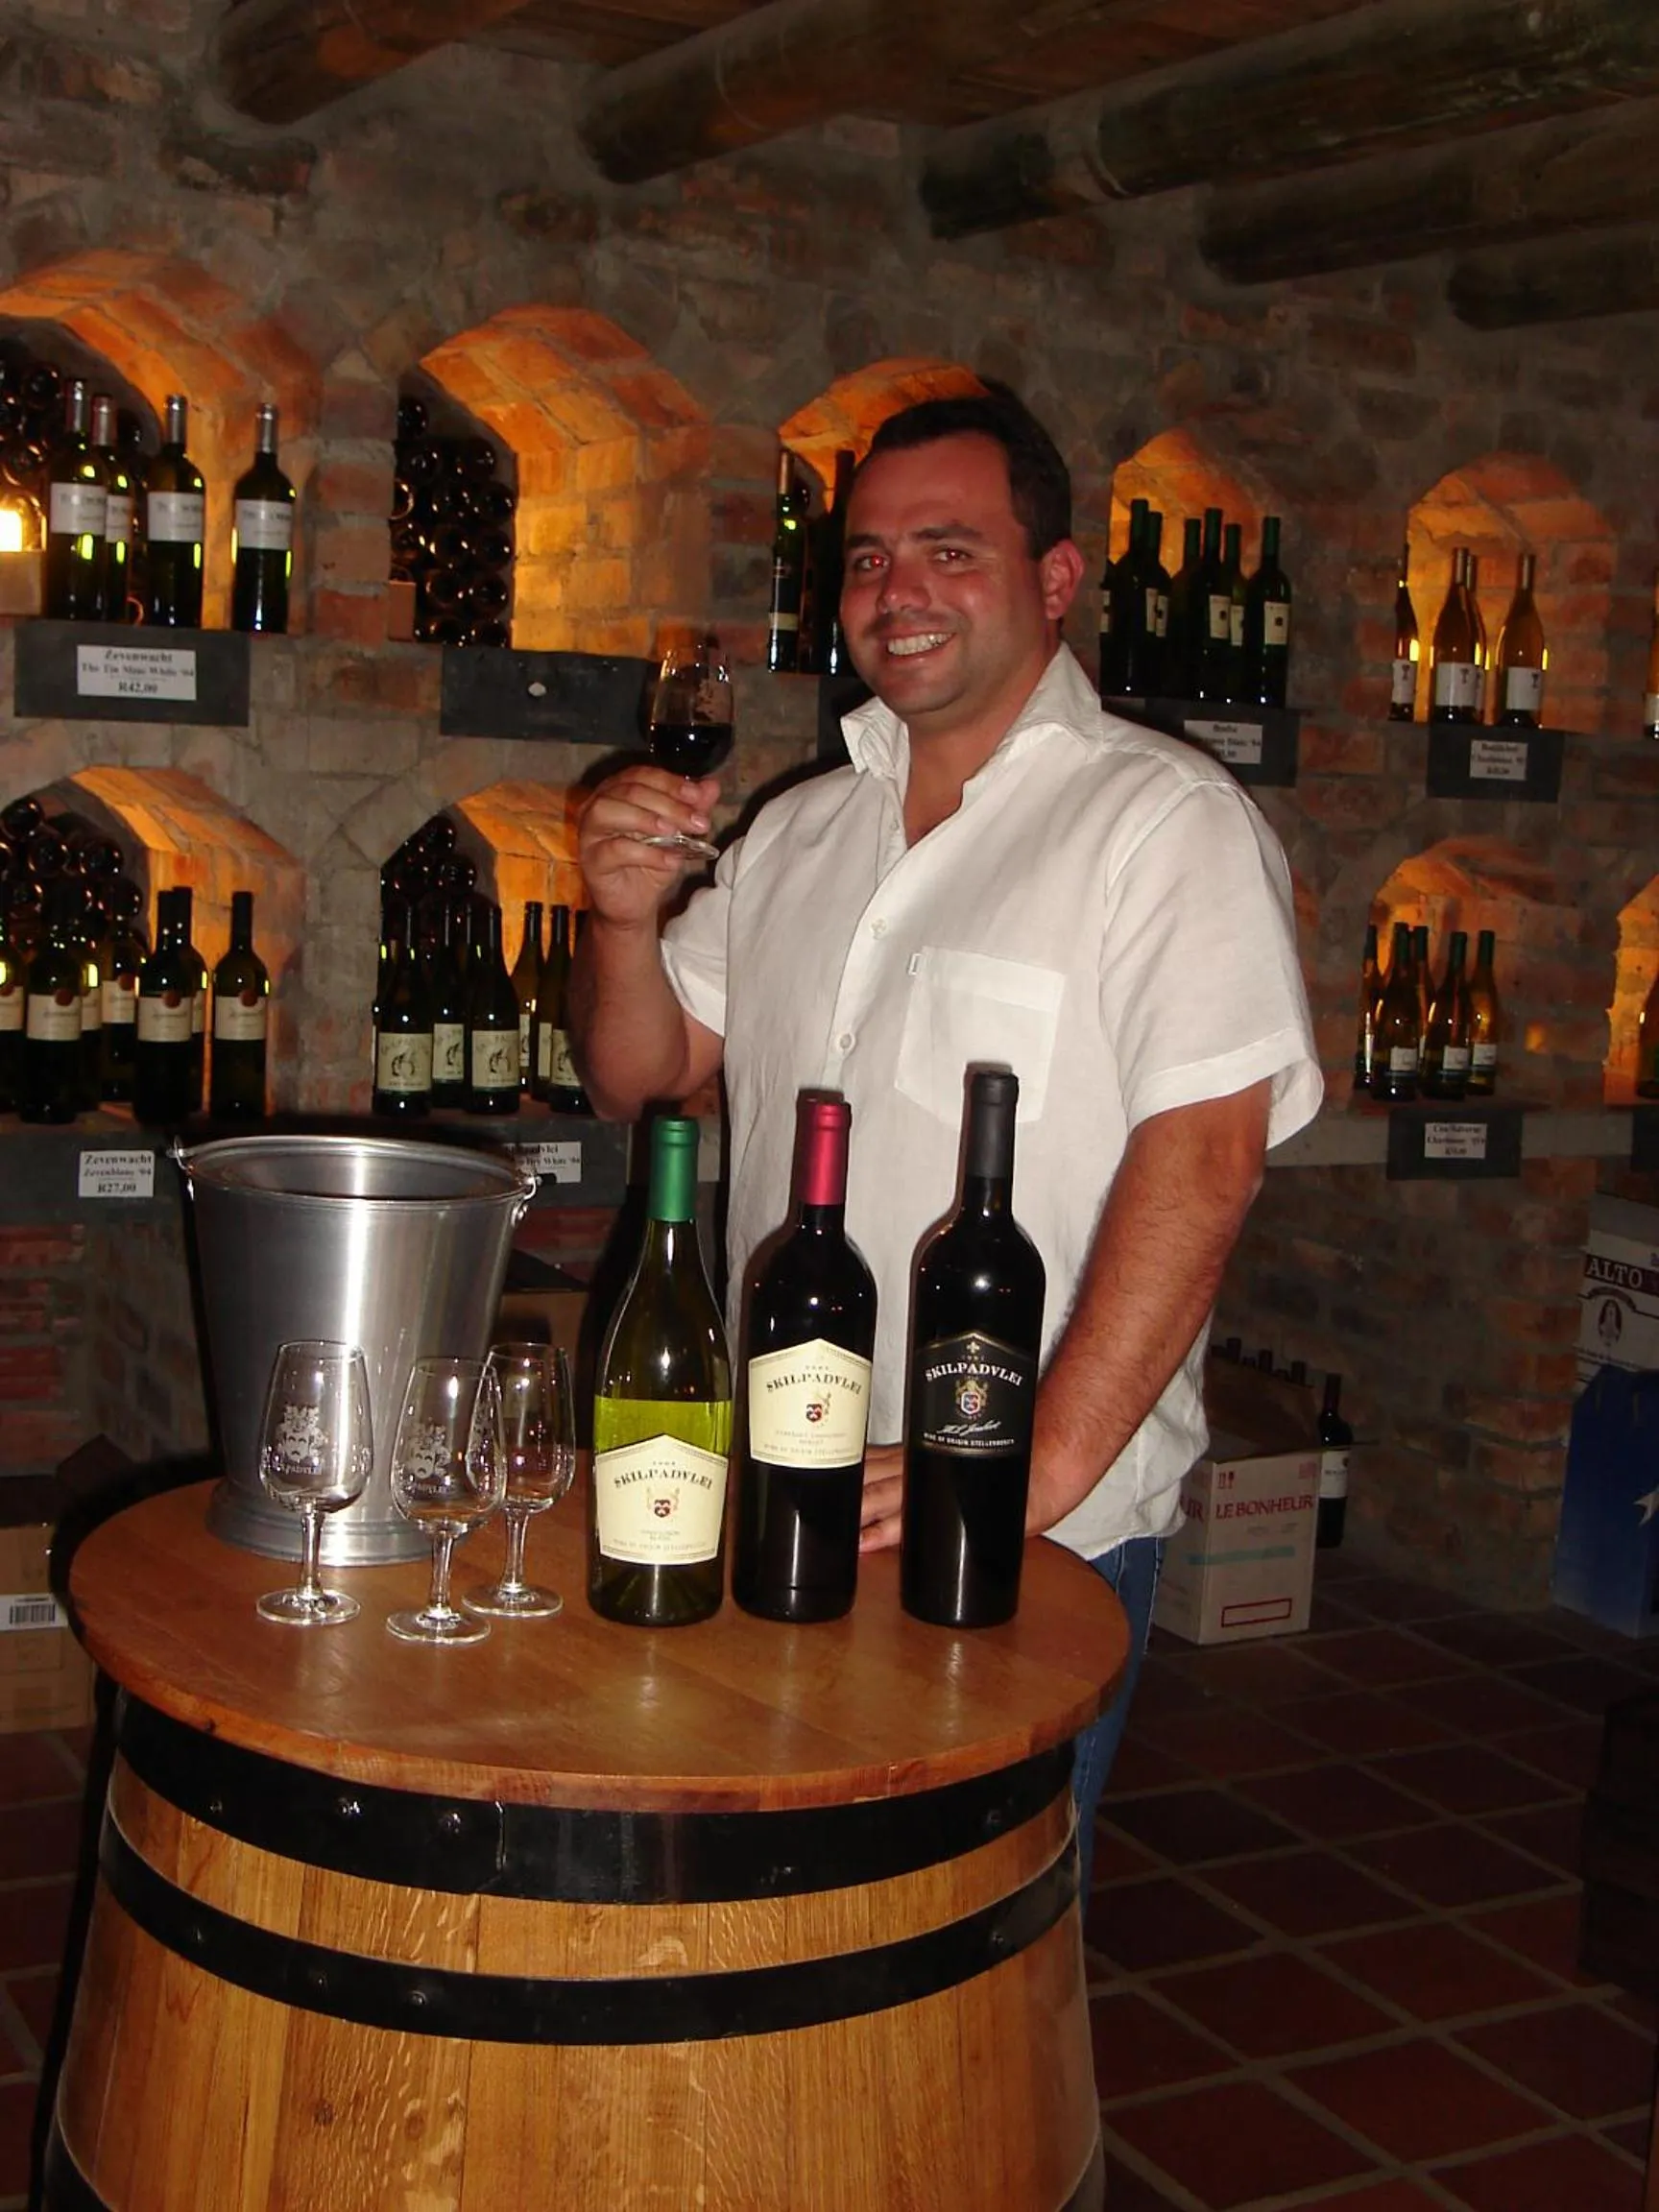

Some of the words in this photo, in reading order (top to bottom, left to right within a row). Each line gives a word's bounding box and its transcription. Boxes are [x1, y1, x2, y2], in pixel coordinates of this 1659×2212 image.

[1587, 1258, 1643, 1288] ALTO
[766, 1373, 862, 1394] SKILPADVLEI
[926, 1362, 1023, 1386] SKILPADVLEI
[613, 1469, 712, 1490] SKILPADVLEI
[1216, 1503, 1233, 1519] LE
[1237, 1495, 1315, 1517] BONHEUR
